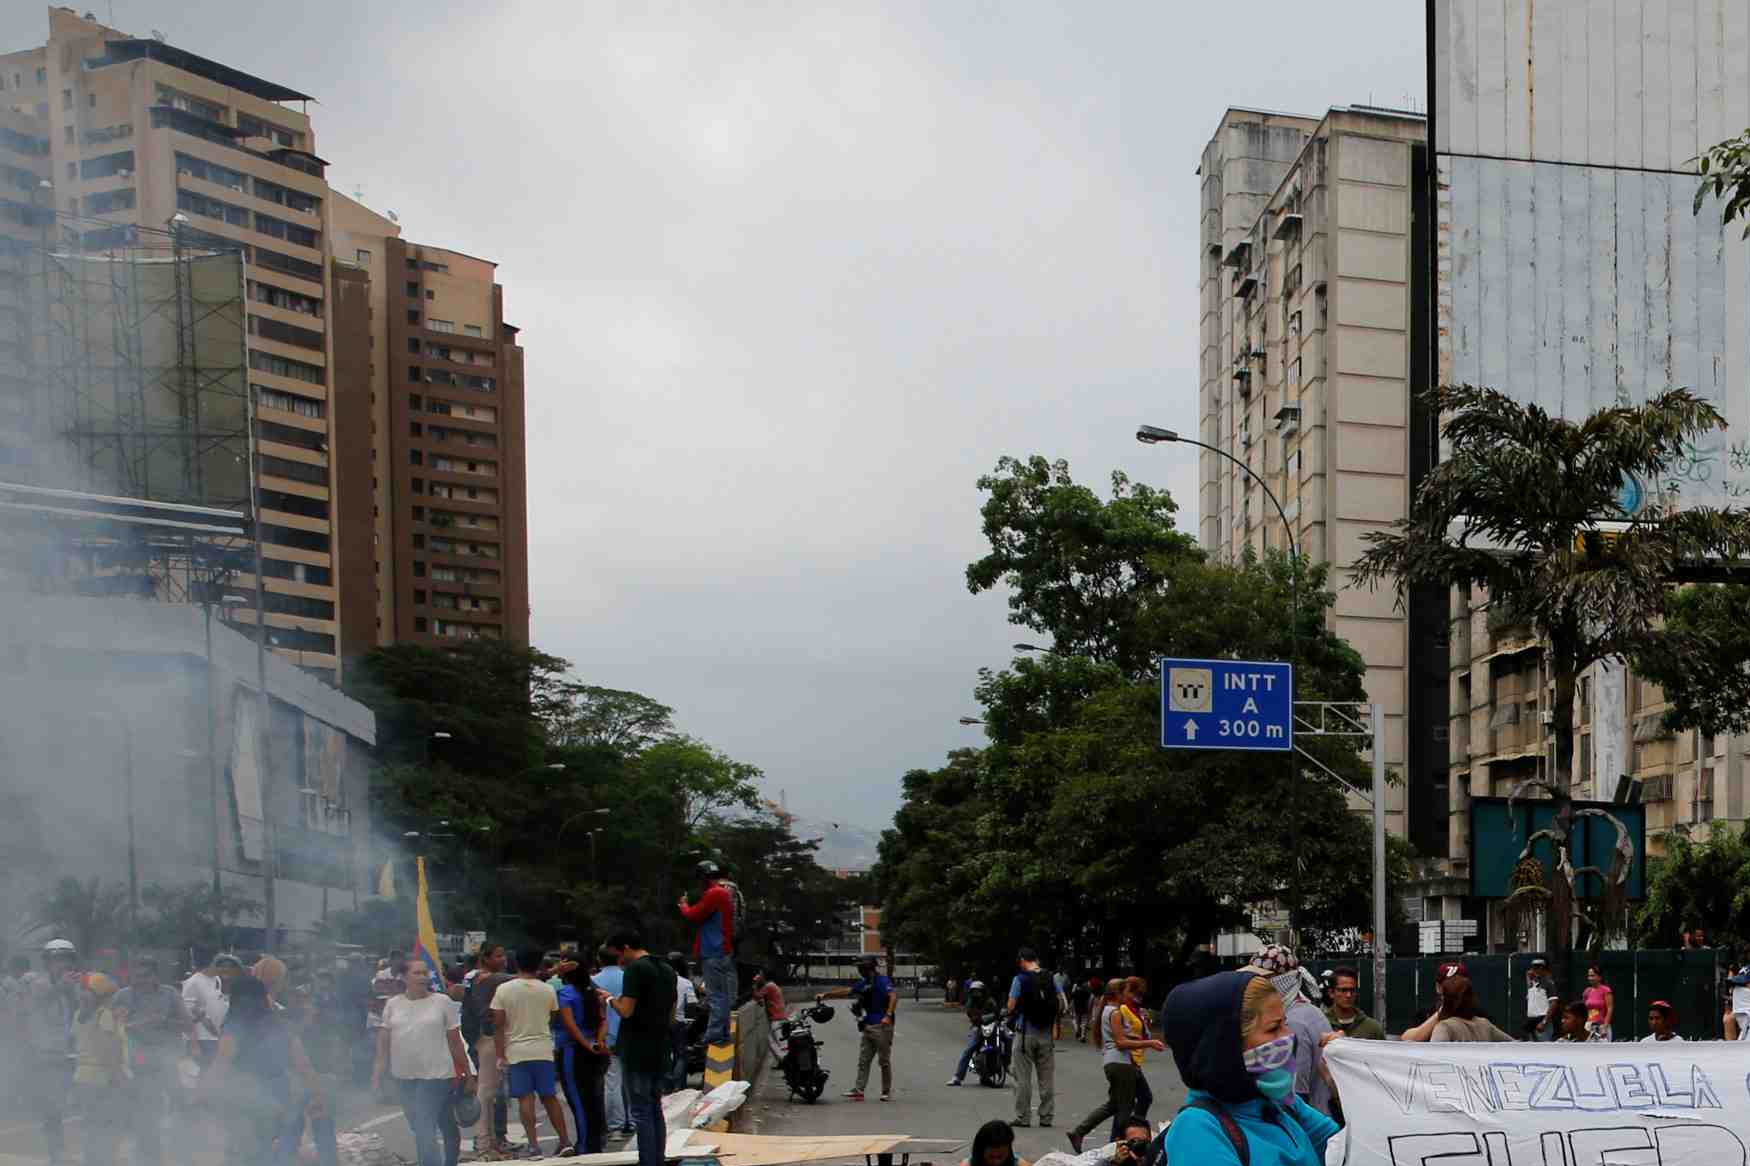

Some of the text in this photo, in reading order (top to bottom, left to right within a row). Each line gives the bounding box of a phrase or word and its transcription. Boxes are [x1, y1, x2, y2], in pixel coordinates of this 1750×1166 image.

[1224, 673, 1276, 691] INTT
[1242, 697, 1259, 714] A
[1218, 719, 1284, 738] 300 m
[1363, 1061, 1723, 1115] VENEZUELA
